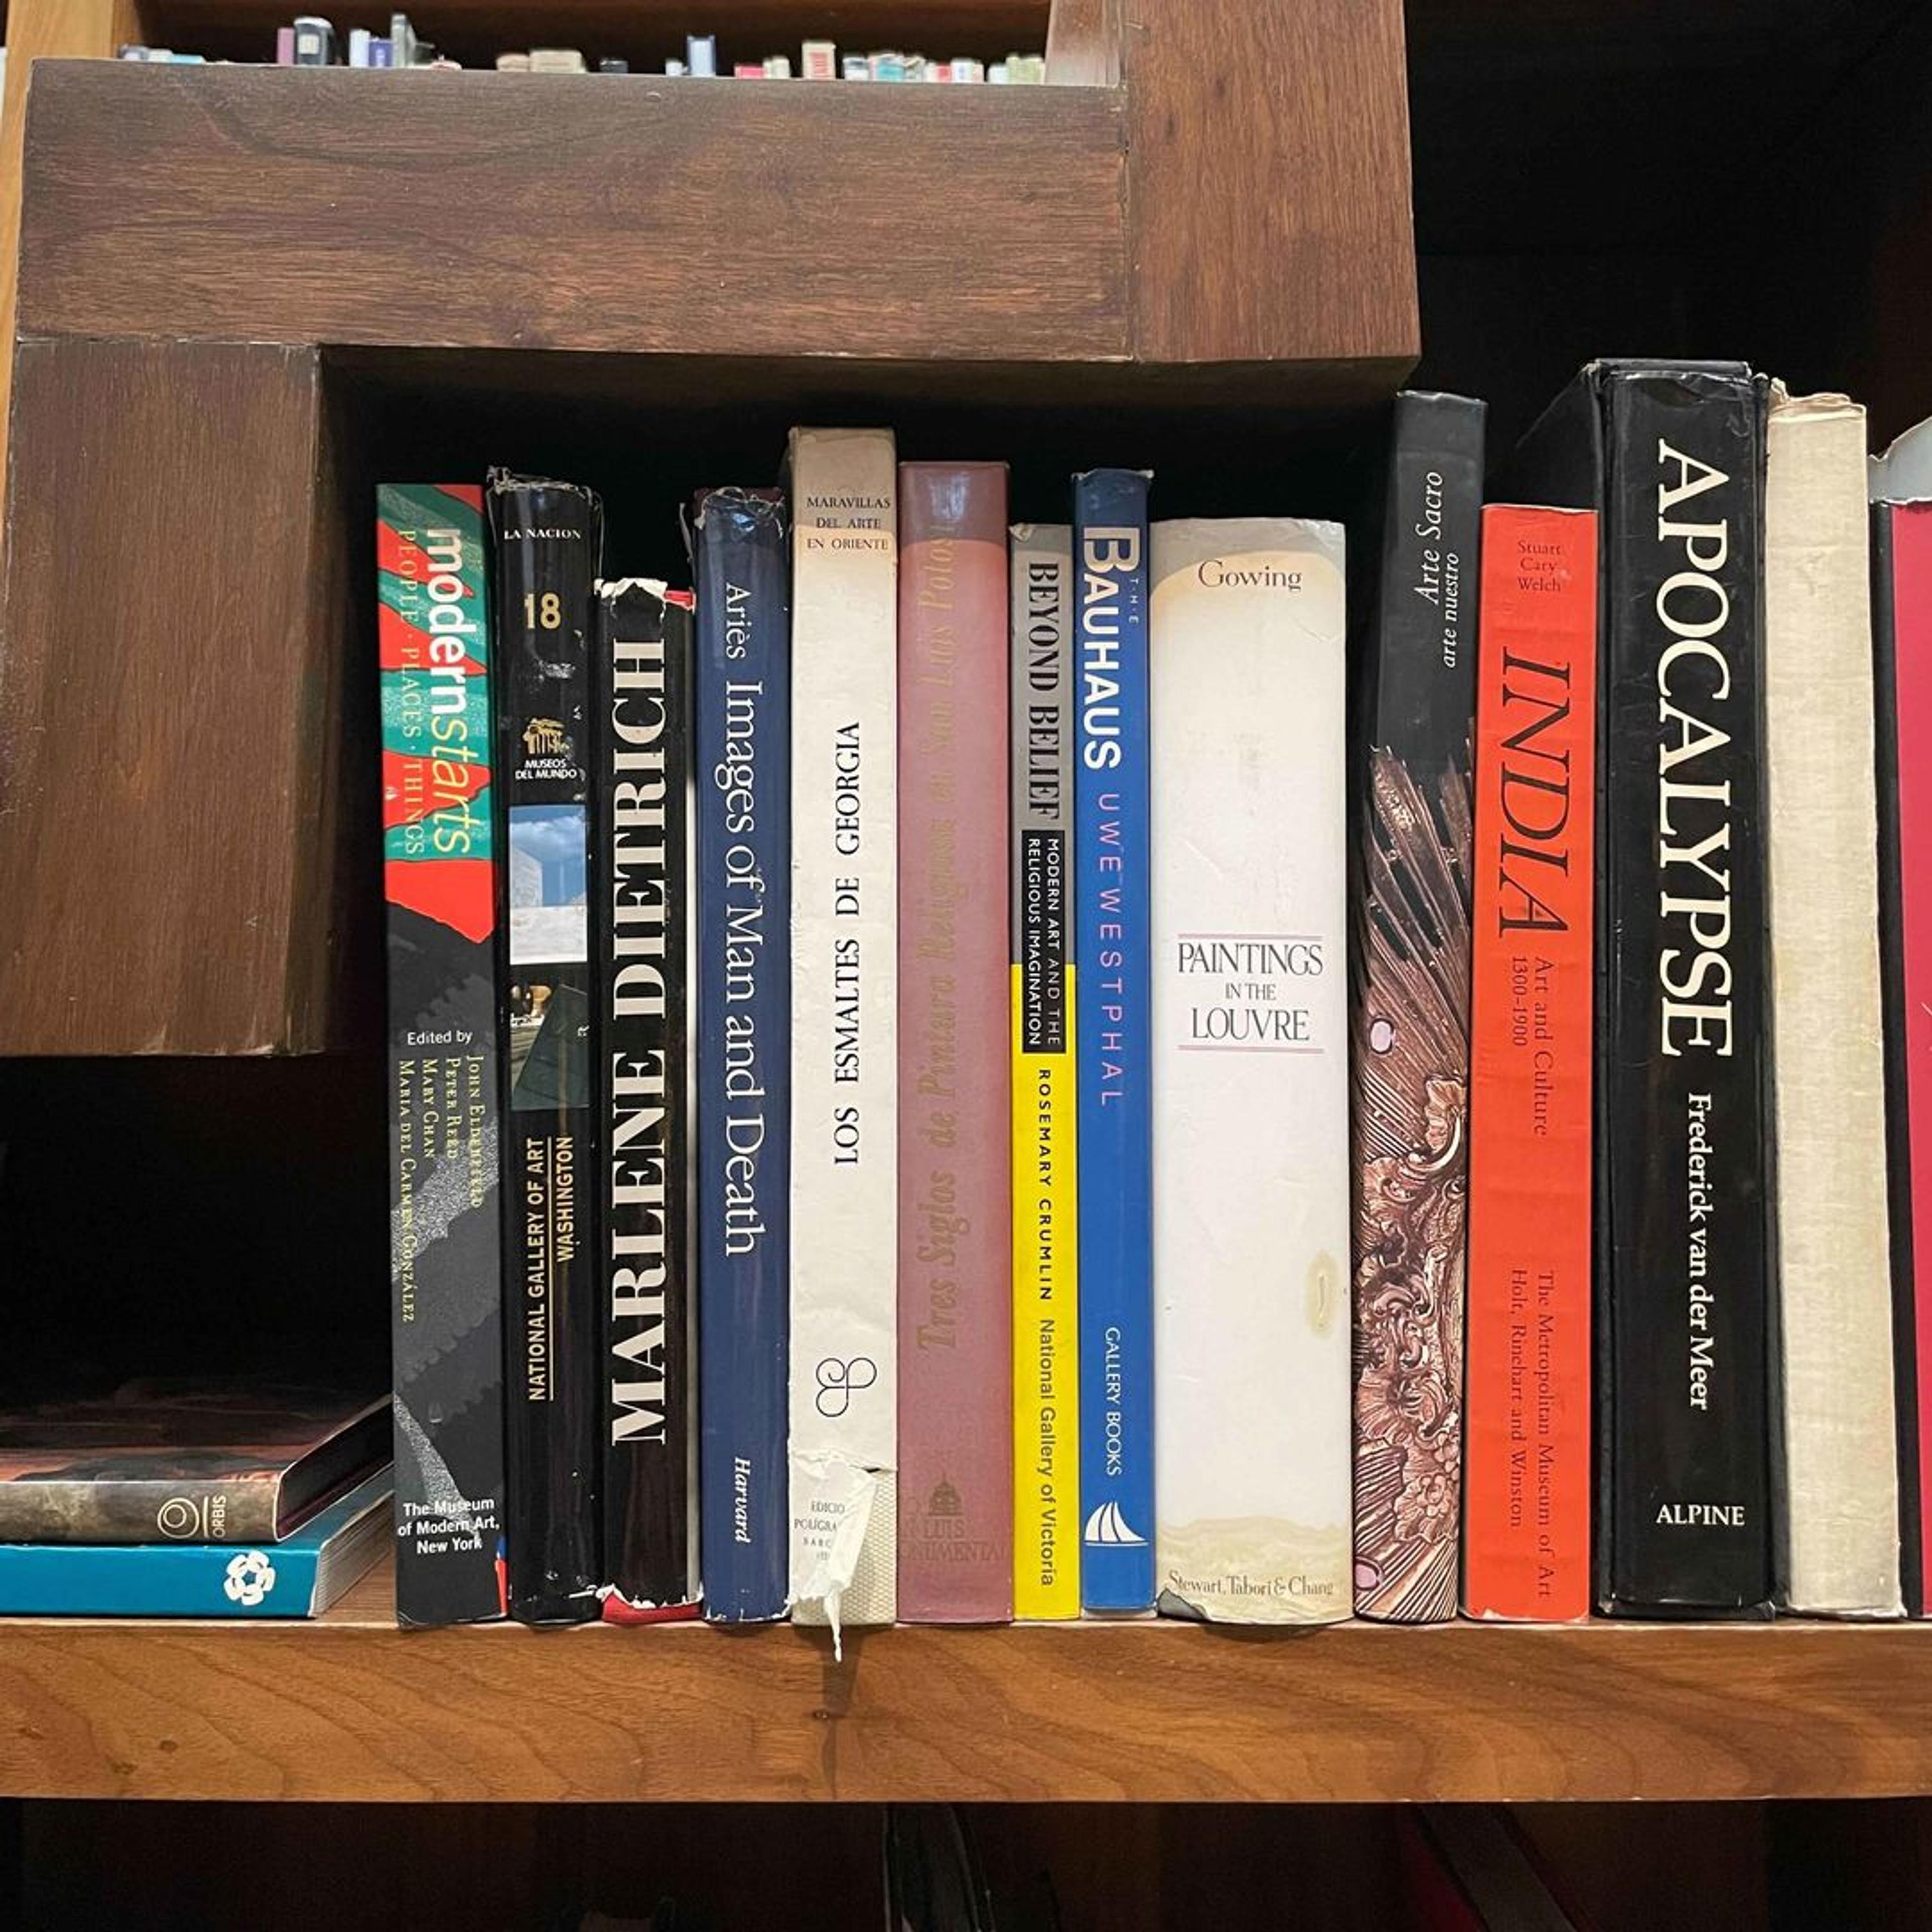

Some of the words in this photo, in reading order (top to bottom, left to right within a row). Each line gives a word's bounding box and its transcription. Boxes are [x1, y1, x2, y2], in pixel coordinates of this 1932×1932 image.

[807, 496, 891, 509] MARAVILLAS
[817, 517, 841, 529] DEL
[847, 518, 881, 529] ARTE
[1414, 471, 1443, 540] Sacro
[504, 529, 522, 540] LA
[526, 528, 581, 539] NACION
[807, 538, 824, 549] EN
[831, 538, 889, 550] ORIENTE
[1517, 540, 1561, 555] Stuart
[398, 530, 419, 623] PEOPLE
[1198, 559, 1302, 591] Gowing
[1413, 549, 1440, 606] Arte
[1444, 552, 1460, 622] nuestro
[1517, 578, 1561, 592] Welch
[1520, 556, 1558, 576] Cary
[524, 593, 561, 629] 18
[725, 582, 752, 660] Ariès
[1029, 563, 1060, 692] BEYOND
[1082, 526, 1141, 769] BAUHAUS
[1441, 628, 1457, 669] arte
[400, 648, 422, 738] PLACES
[514, 769, 533, 780] DEL
[535, 768, 578, 779] MUNDO
[524, 758, 567, 769] MUSEOS
[714, 680, 764, 834] Images
[1029, 706, 1060, 820] BELIEF
[1656, 438, 1733, 1057] APOCALYPSE
[404, 758, 425, 855] THINGS
[835, 721, 861, 855] GEORGIA
[1499, 646, 1570, 938] INDIA
[612, 637, 667, 1021] DIETRICH
[1098, 793, 1122, 873] UWE
[725, 845, 765, 893] of
[835, 877, 860, 917] DE
[1028, 838, 1041, 923] RELIGIOUS
[1047, 838, 1060, 911] MODERN
[725, 902, 764, 1004] Man
[1047, 918, 1060, 949] ART
[1178, 942, 1324, 976] PAINTINGS
[1028, 929, 1042, 1045] IMAGINATION
[1047, 958, 1061, 999] AND
[1100, 888, 1123, 1105] WESTPHAL
[1225, 983, 1241, 999] IN
[1244, 983, 1276, 1001] THE
[1512, 956, 1528, 1046] 1300-1900
[1534, 956, 1555, 993] Art
[407, 1030, 452, 1045] Edited
[456, 1030, 473, 1045] by
[834, 938, 860, 1083] ESMALTES
[1048, 1008, 1061, 1044] THE
[1192, 1007, 1310, 1040] LOUVRE
[1534, 1002, 1554, 1040] and
[422, 1059, 438, 1105] MARY
[446, 1058, 461, 1109] PETER
[467, 1055, 484, 1098] JOHN
[725, 1014, 766, 1102] and
[399, 1060, 416, 1116] MARIA
[1534, 1050, 1554, 1136] Culture
[423, 1110, 440, 1158] CHAN
[447, 1115, 462, 1158] REED
[834, 1107, 860, 1164] LOS
[925, 1110, 957, 1149] de
[1038, 1069, 1052, 1187] ROSEMARY
[526, 1138, 544, 1175] ART
[1688, 1092, 1714, 1223] Frederick
[400, 1158, 417, 1229] CARMEN
[527, 1181, 545, 1204] OF
[556, 1136, 574, 1263] WASHINGTON
[725, 1114, 767, 1257] Death
[527, 1212, 546, 1298] GALLERY
[612, 1049, 667, 1447] MARLENE
[1038, 1198, 1052, 1301] CRUMLIN
[1688, 1228, 1708, 1278] van
[916, 1278, 957, 1350] Tres
[1511, 1269, 1528, 1315] Holt,
[1538, 1270, 1555, 1306] The
[1689, 1284, 1715, 1331] der
[528, 1303, 546, 1401] NATIONAL
[1039, 1319, 1055, 1400] National
[1105, 1327, 1121, 1405] GALLERY
[1511, 1325, 1528, 1401] Rinehart
[1534, 1314, 1555, 1435] Metropolitan
[1689, 1336, 1715, 1411] Meer
[1037, 1406, 1057, 1477] Gallery
[1105, 1412, 1122, 1477] BOOKS
[1511, 1409, 1527, 1441] and
[403, 1501, 431, 1516] The
[434, 1498, 495, 1515] Museum
[734, 1457, 752, 1544] Harvard
[811, 1500, 845, 1515] EDICIO
[1040, 1483, 1057, 1503] of
[1510, 1450, 1527, 1527] Winston
[1538, 1444, 1555, 1526] Museum
[212, 1494, 227, 1539] ORBIS
[397, 1521, 412, 1536] of
[416, 1518, 469, 1535] Modern
[473, 1514, 500, 1530] Art,
[1656, 1504, 1745, 1526] ALPINE
[417, 1540, 448, 1554] New
[452, 1535, 482, 1551] York
[1040, 1508, 1057, 1586] Victoria
[1538, 1535, 1555, 1558] of
[1169, 1569, 1226, 1595] Stewart,
[1227, 1575, 1271, 1596] Tabori
[1274, 1576, 1286, 1596] &
[1288, 1575, 1334, 1596] Chang
[1538, 1566, 1555, 1598] Art
